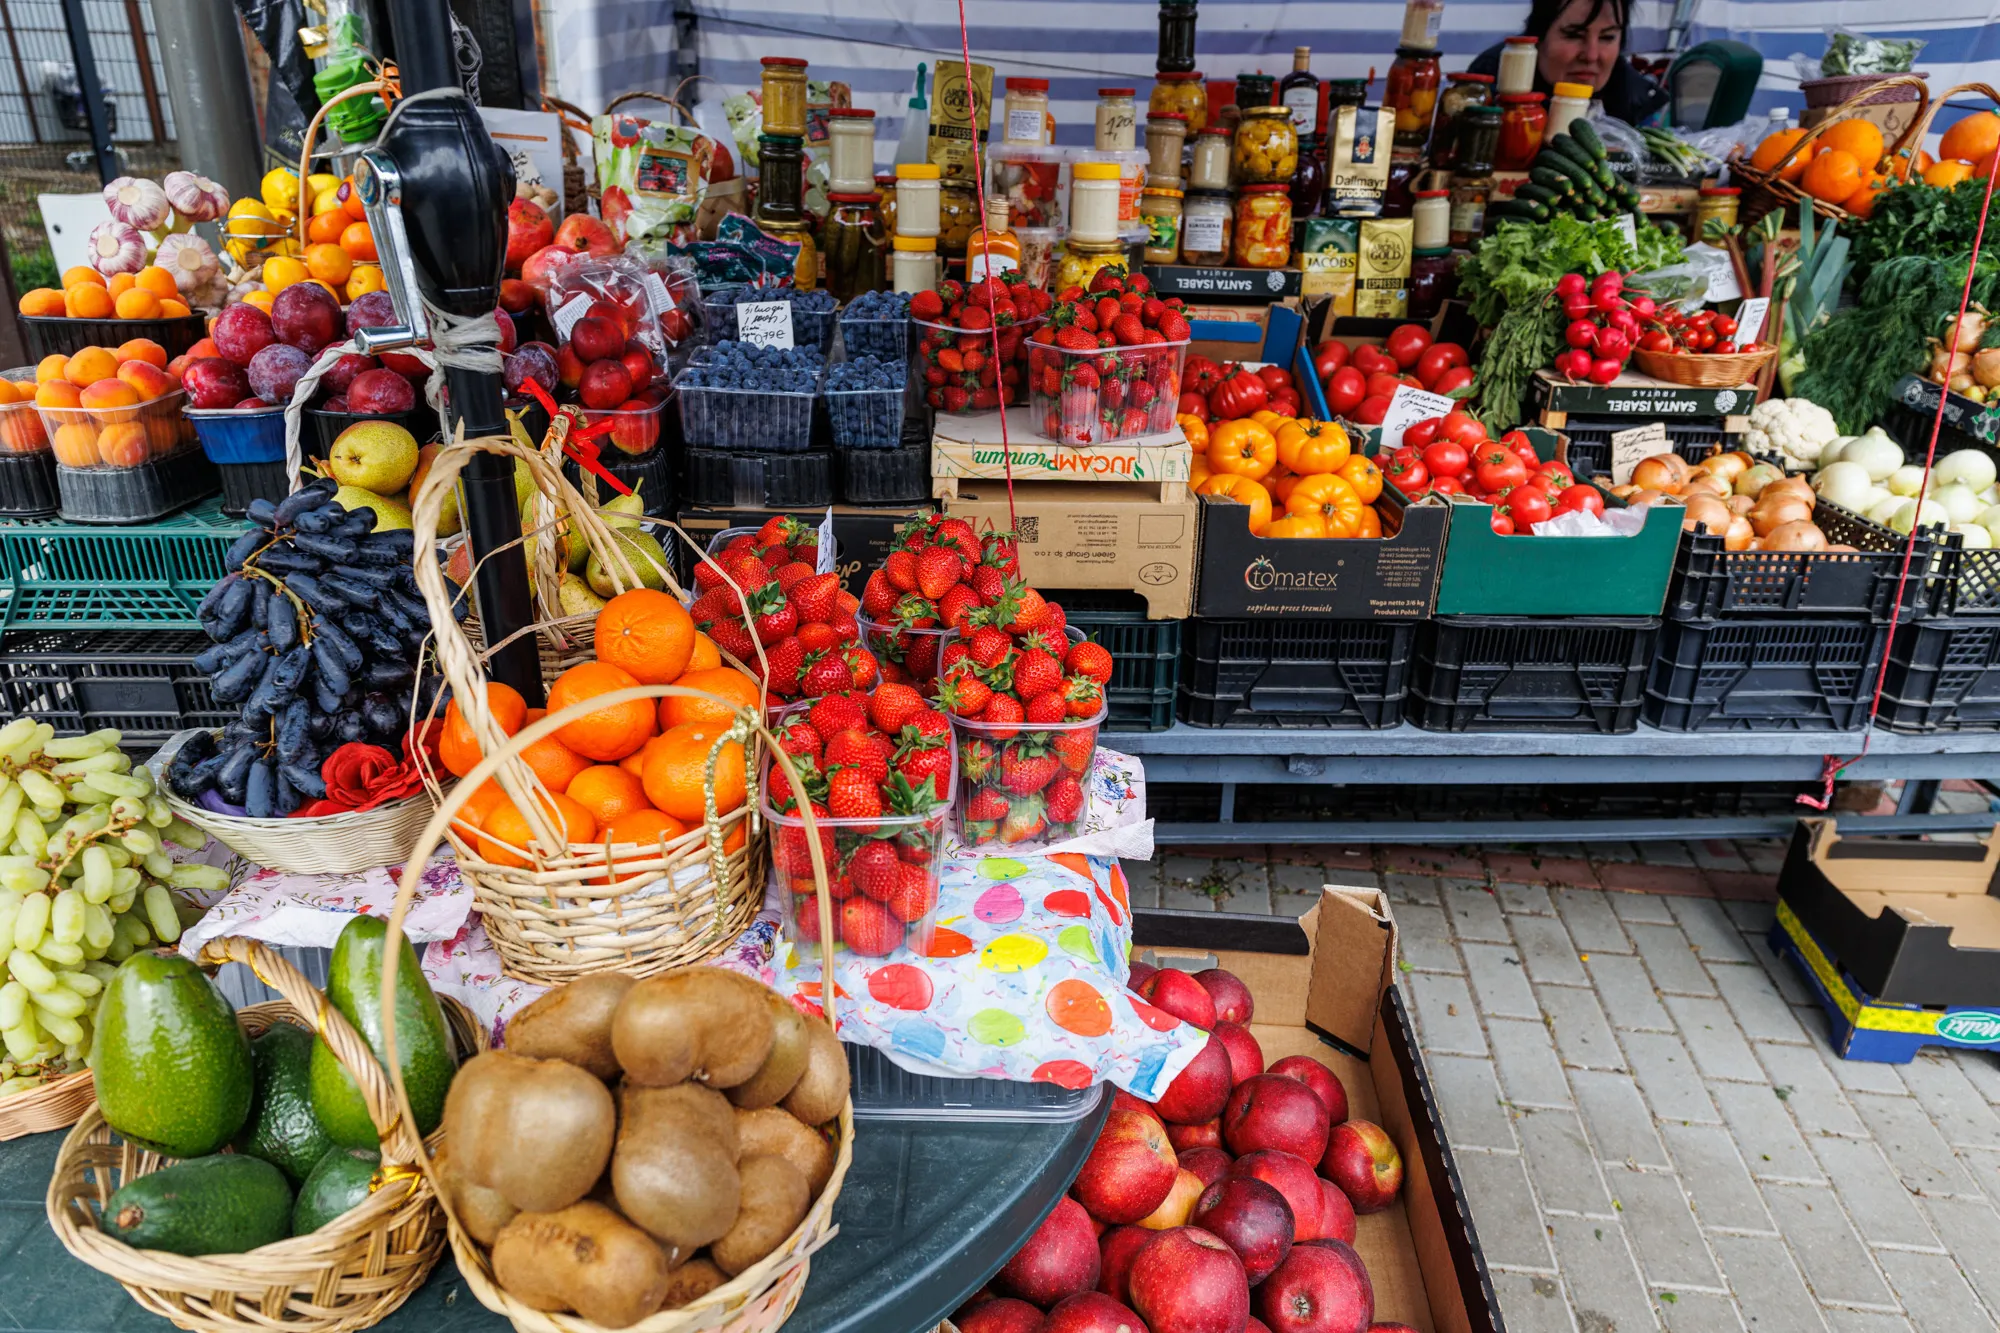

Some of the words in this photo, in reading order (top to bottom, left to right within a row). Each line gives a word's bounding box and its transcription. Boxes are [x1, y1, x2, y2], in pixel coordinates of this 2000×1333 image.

[1335, 175, 1386, 190] Dallmayr
[1336, 187, 1381, 199] prodomo
[1370, 251, 1401, 260] GOLD
[1305, 256, 1356, 268] JACOBS
[1176, 278, 1214, 290] ISABEL
[1216, 280, 1253, 291] SANTA
[1631, 390, 1676, 398] FRUTAS
[1607, 400, 1652, 412] ISABEL
[1653, 400, 1698, 412] SANTA
[1091, 551, 1116, 559] Green
[1253, 570, 1338, 587] tomatex
[1246, 603, 1279, 613] zapylane
[1279, 604, 1300, 614] przez
[1301, 603, 1333, 612] trzmiele
